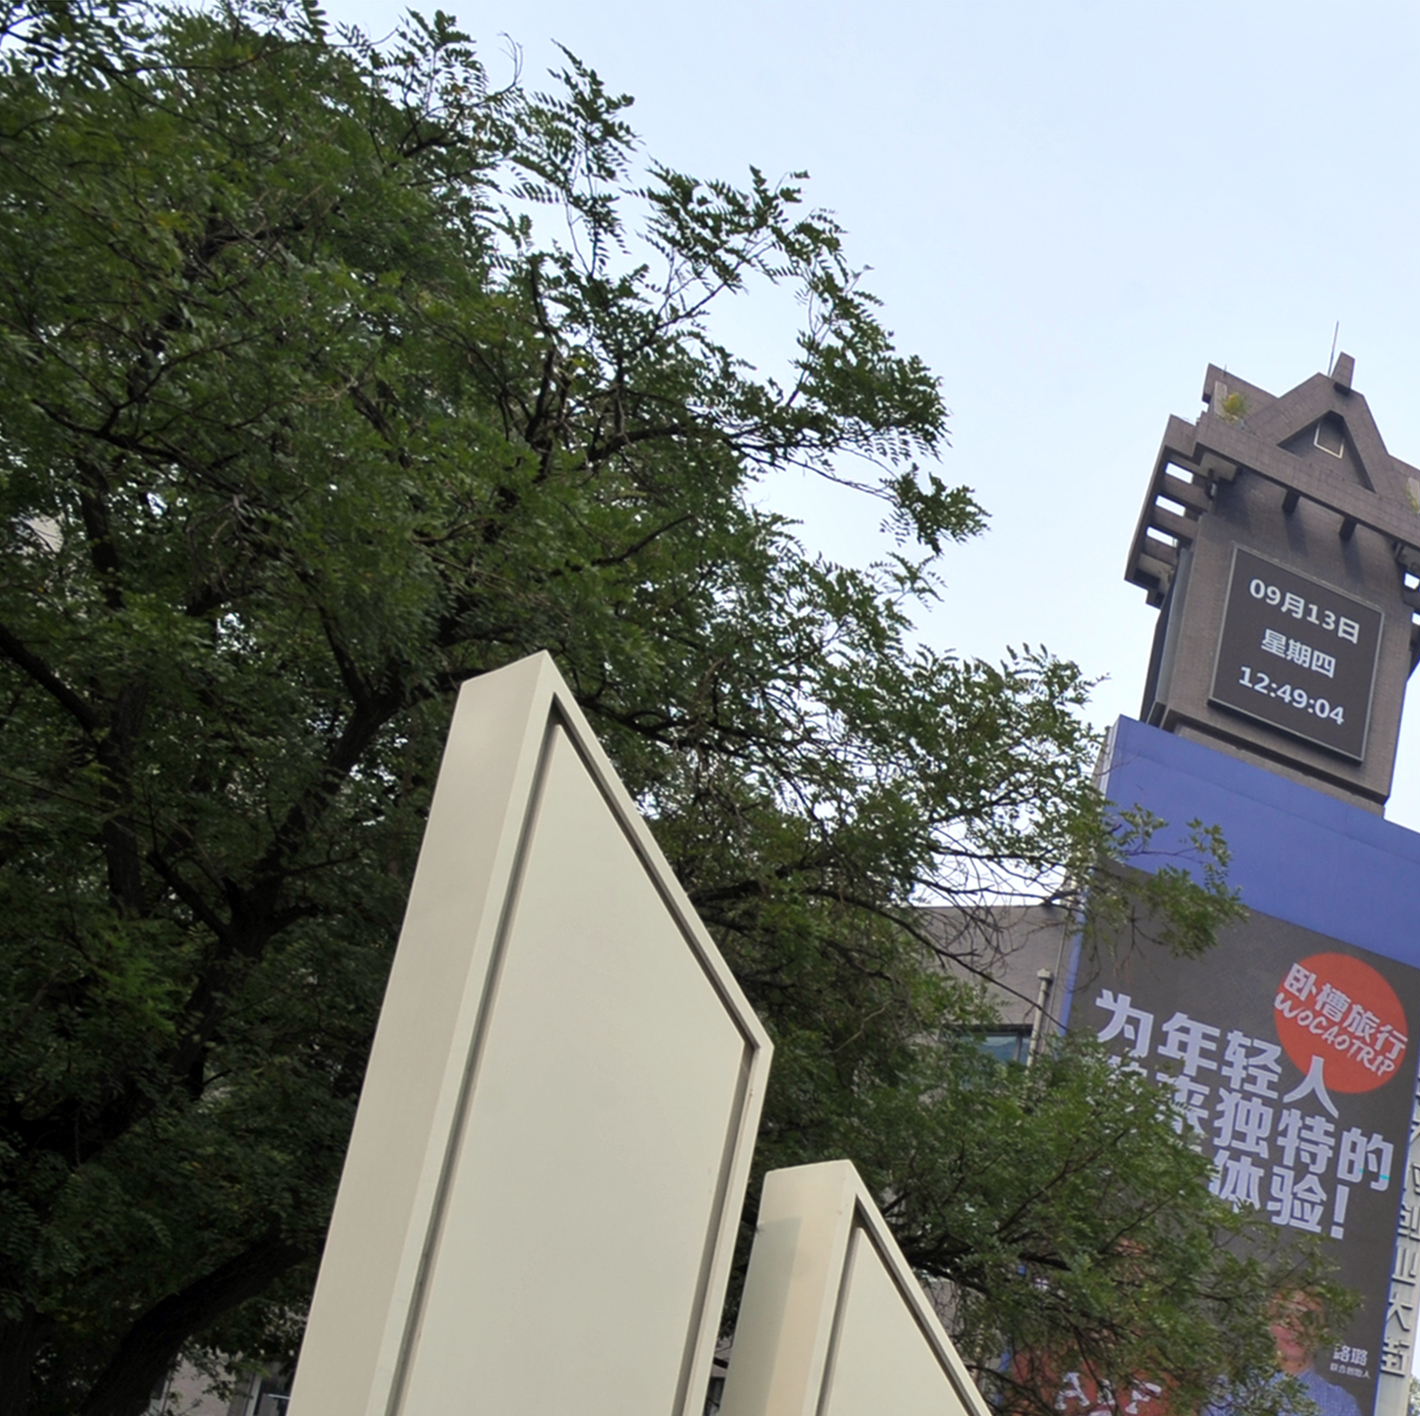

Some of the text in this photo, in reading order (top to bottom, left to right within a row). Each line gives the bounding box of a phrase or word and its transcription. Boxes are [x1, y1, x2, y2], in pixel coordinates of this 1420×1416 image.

[1249, 578, 1360, 644] 09月13日
[1261, 628, 1336, 679] 星期四
[1238, 666, 1345, 725] 12:49:04
[1274, 992, 1395, 1076] WOCAOTRIP
[1284, 962, 1408, 1060] 卧槽旅行
[1095, 988, 1339, 1118] 为年轻人
